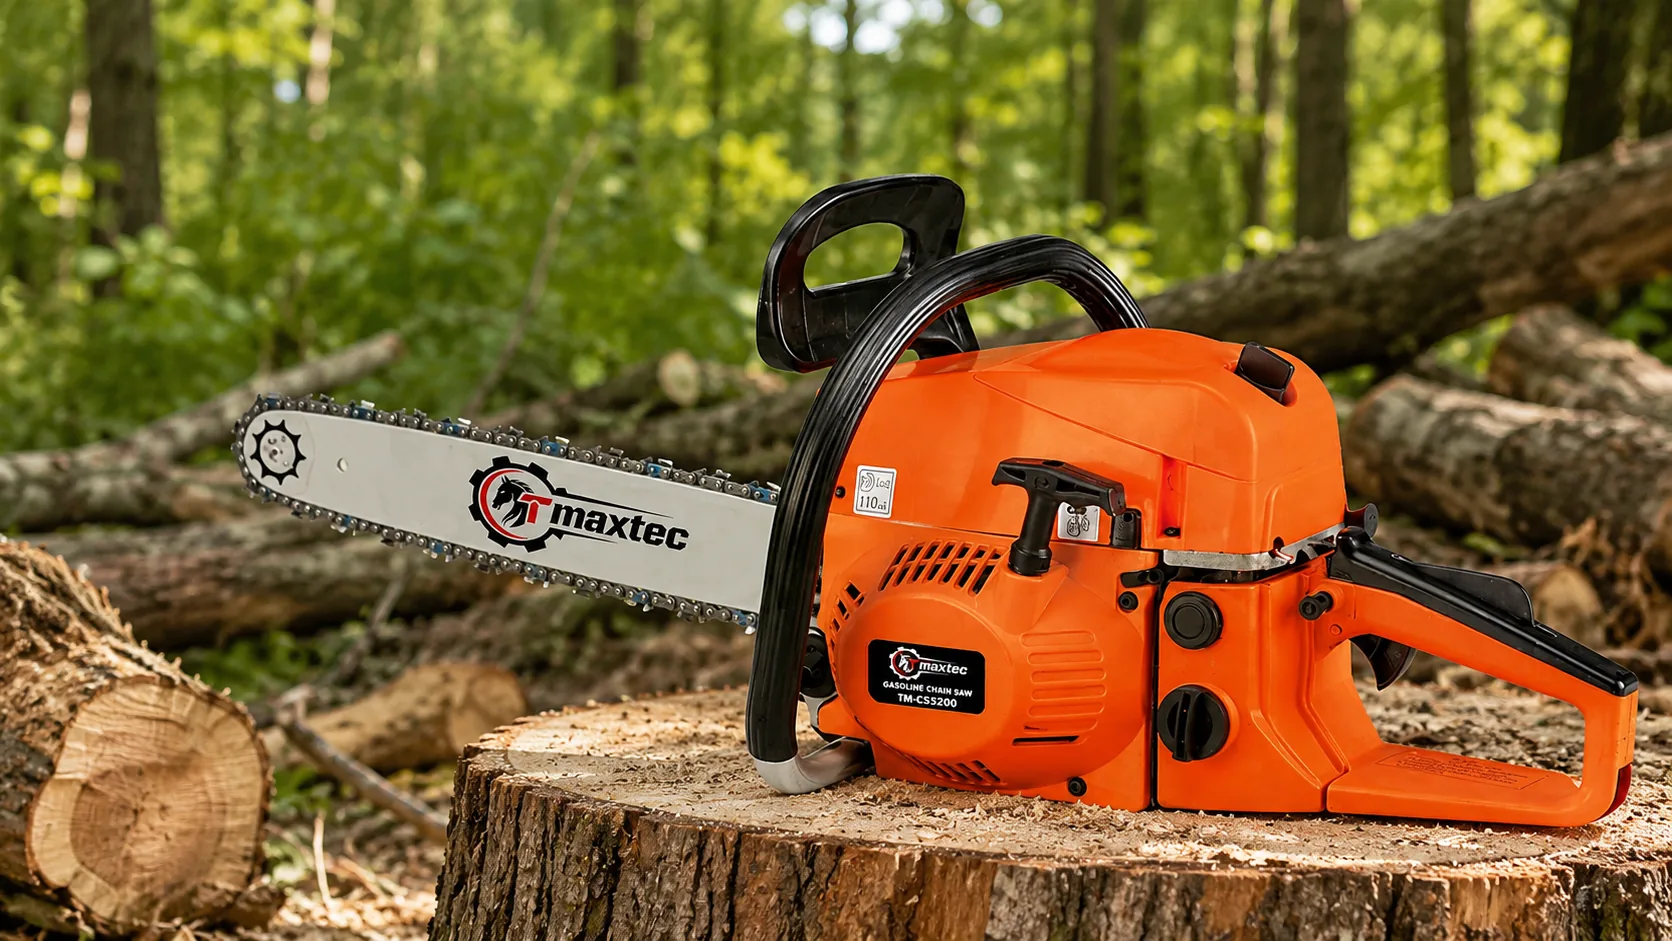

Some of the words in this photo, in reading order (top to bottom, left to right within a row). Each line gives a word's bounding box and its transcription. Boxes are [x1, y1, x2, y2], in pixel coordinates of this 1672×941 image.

[882, 681, 924, 693] GASOLINE
[926, 685, 952, 696] CHAIN
[953, 689, 973, 698] SAW
[897, 693, 958, 709] TM-CS5200
